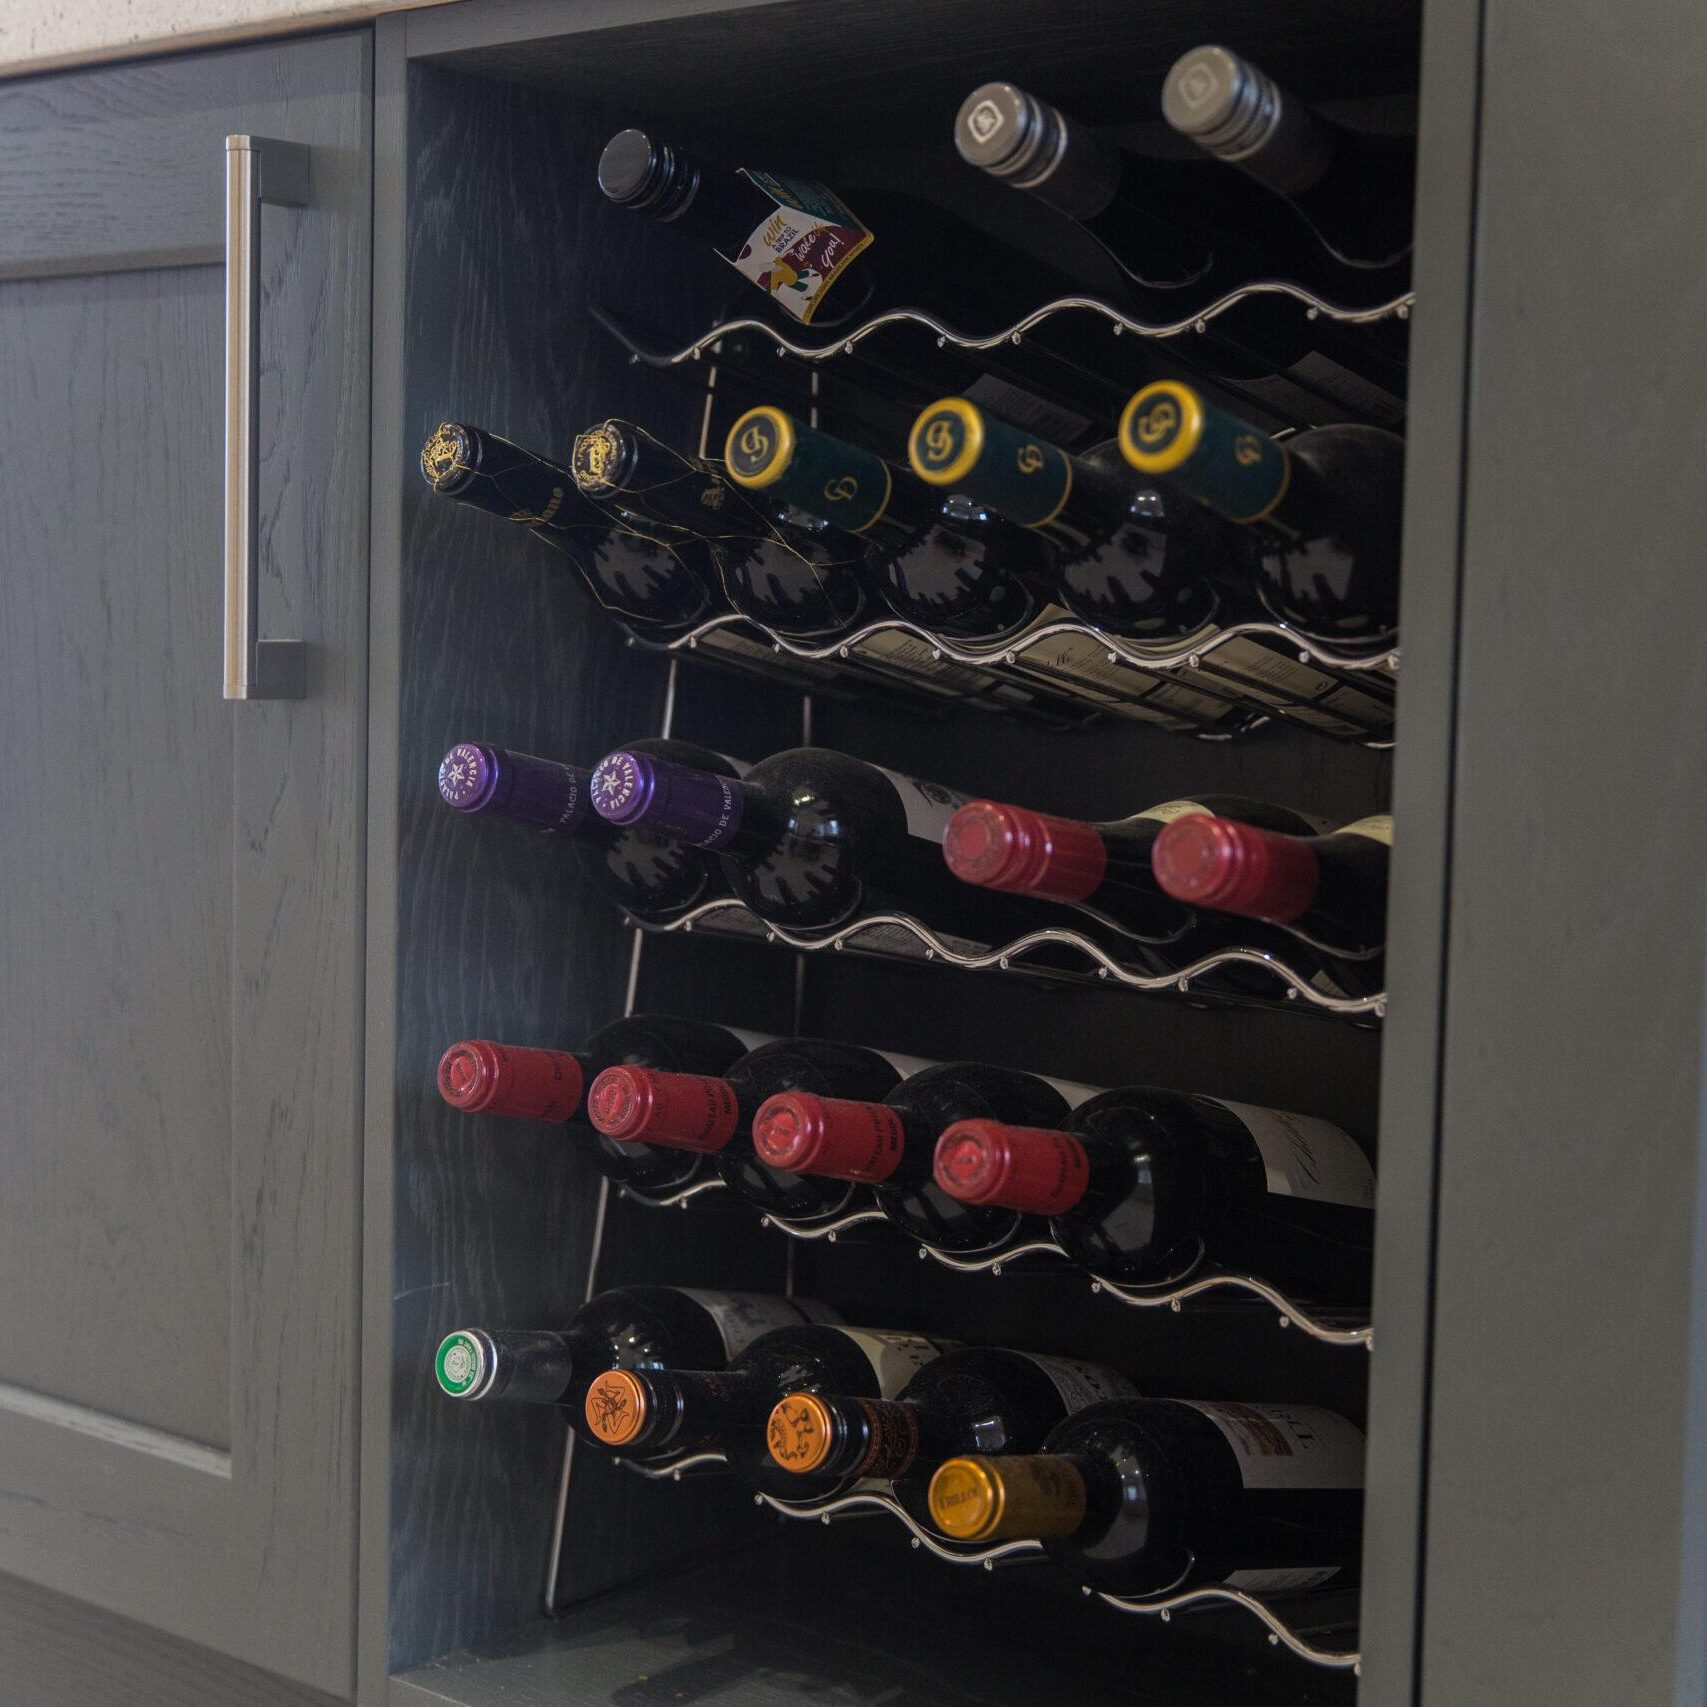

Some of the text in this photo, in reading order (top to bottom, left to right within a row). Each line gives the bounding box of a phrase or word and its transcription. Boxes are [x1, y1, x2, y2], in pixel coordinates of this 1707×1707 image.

[775, 229, 799, 253] BRAZIL
[457, 748, 477, 787] VALENCIA
[611, 756, 624, 766] DE
[609, 762, 634, 809] VALENCIA
[560, 786, 578, 824] PALACIO
[718, 814, 730, 828] DE
